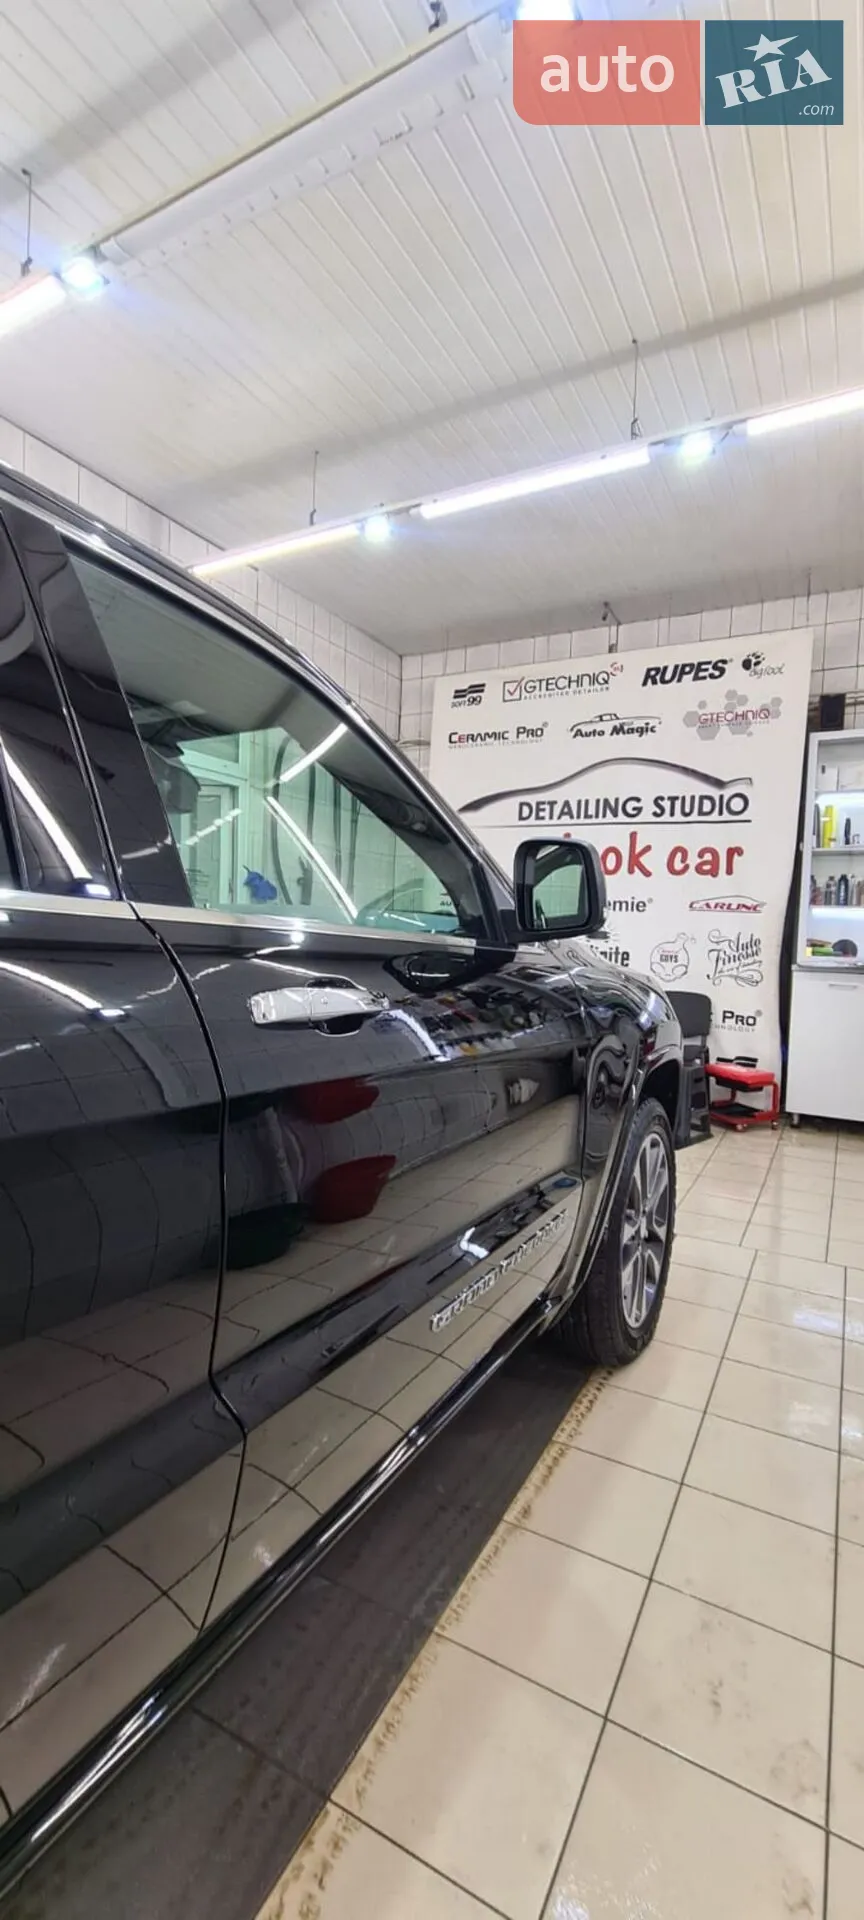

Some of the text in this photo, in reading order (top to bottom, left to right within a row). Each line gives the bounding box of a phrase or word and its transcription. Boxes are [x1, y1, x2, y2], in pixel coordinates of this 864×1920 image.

[523, 669, 611, 694] GTECHNIQ
[641, 658, 729, 688] RUPES
[698, 708, 771, 725] GTECHNIQ
[571, 726, 606, 739] Auto
[610, 722, 657, 738] Magic
[517, 792, 750, 821] DETAILING STUDIO
[600, 830, 744, 878] ok car
